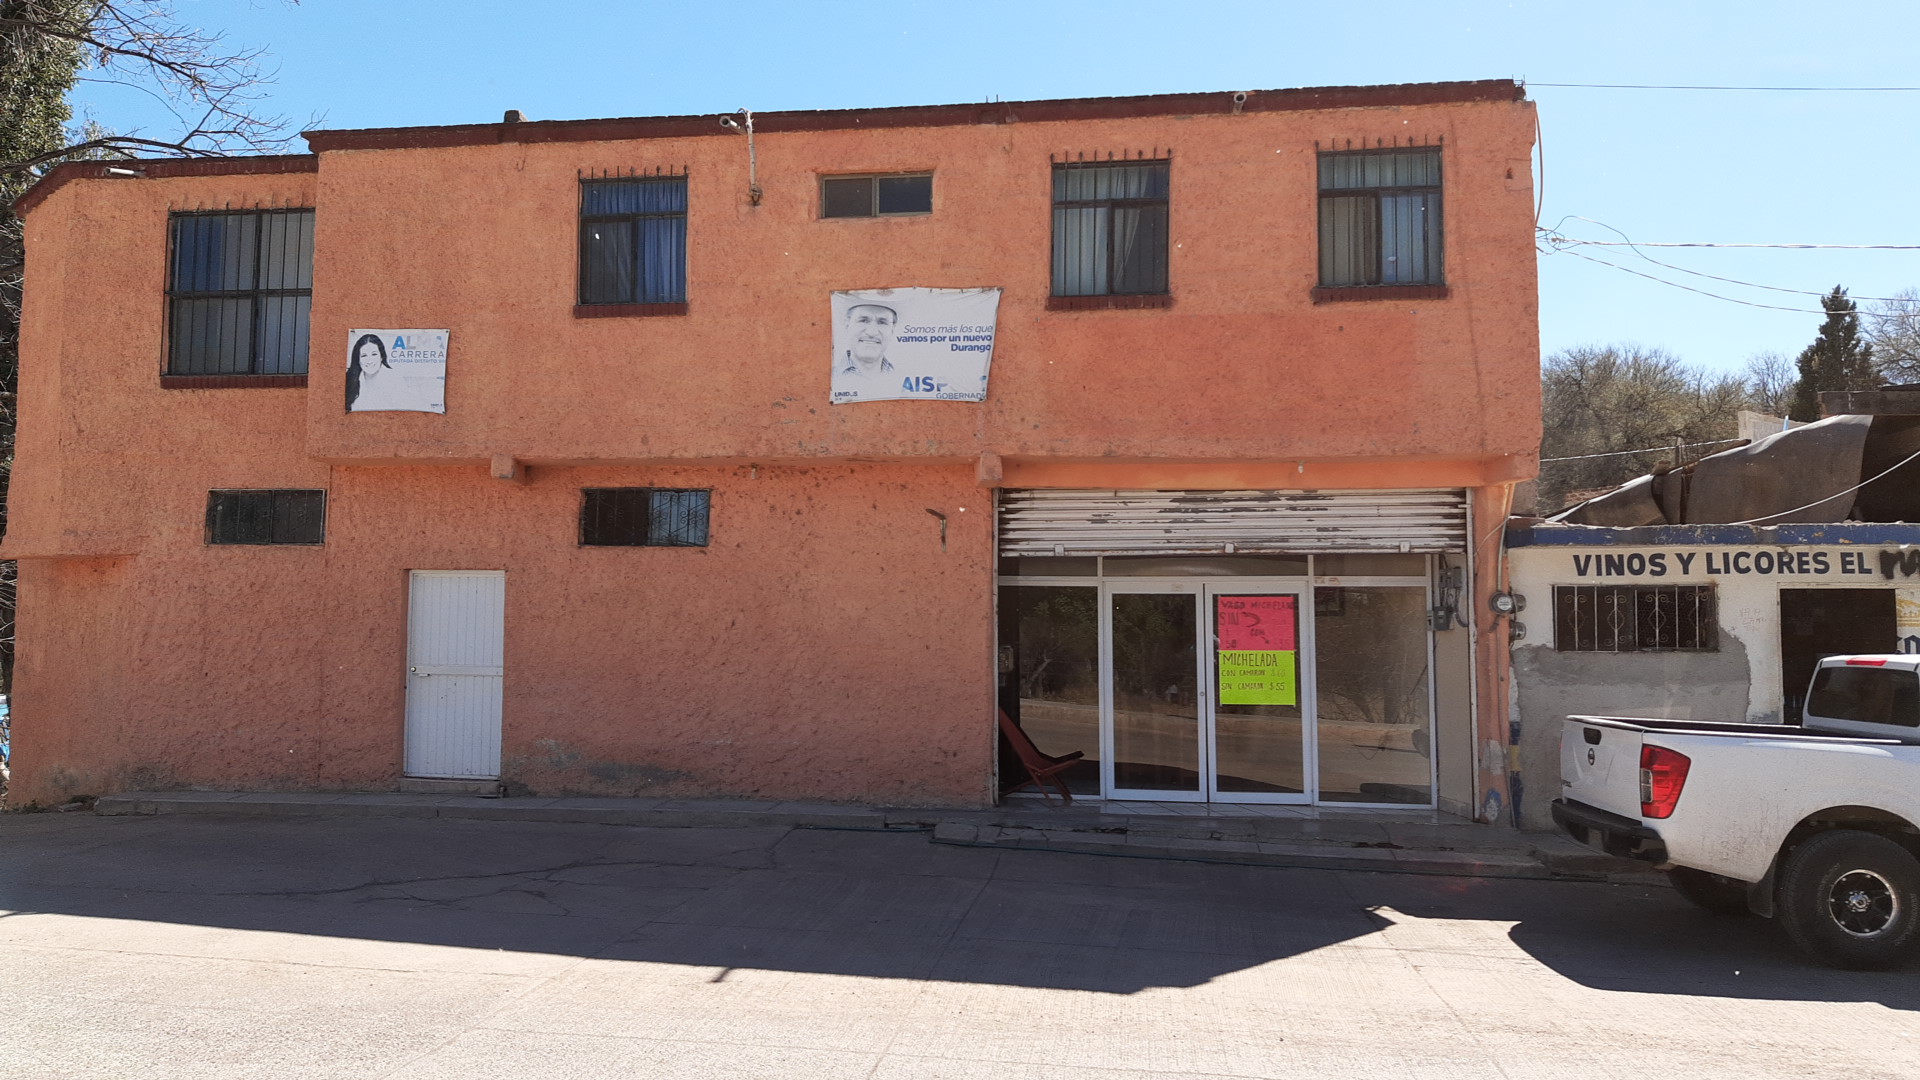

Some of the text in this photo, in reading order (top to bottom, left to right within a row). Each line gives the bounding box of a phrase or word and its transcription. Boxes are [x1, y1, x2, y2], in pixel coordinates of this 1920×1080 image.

[904, 324, 993, 334] Somos más los que
[930, 336, 947, 344] por
[951, 344, 991, 352] Durango
[391, 350, 445, 358] CARRERA
[1573, 553, 1667, 576] VINOS
[1674, 552, 1697, 575] Y
[1706, 551, 1830, 574] LICORES
[1840, 552, 1872, 574] EL
[1223, 653, 1278, 666] MICHELADA
